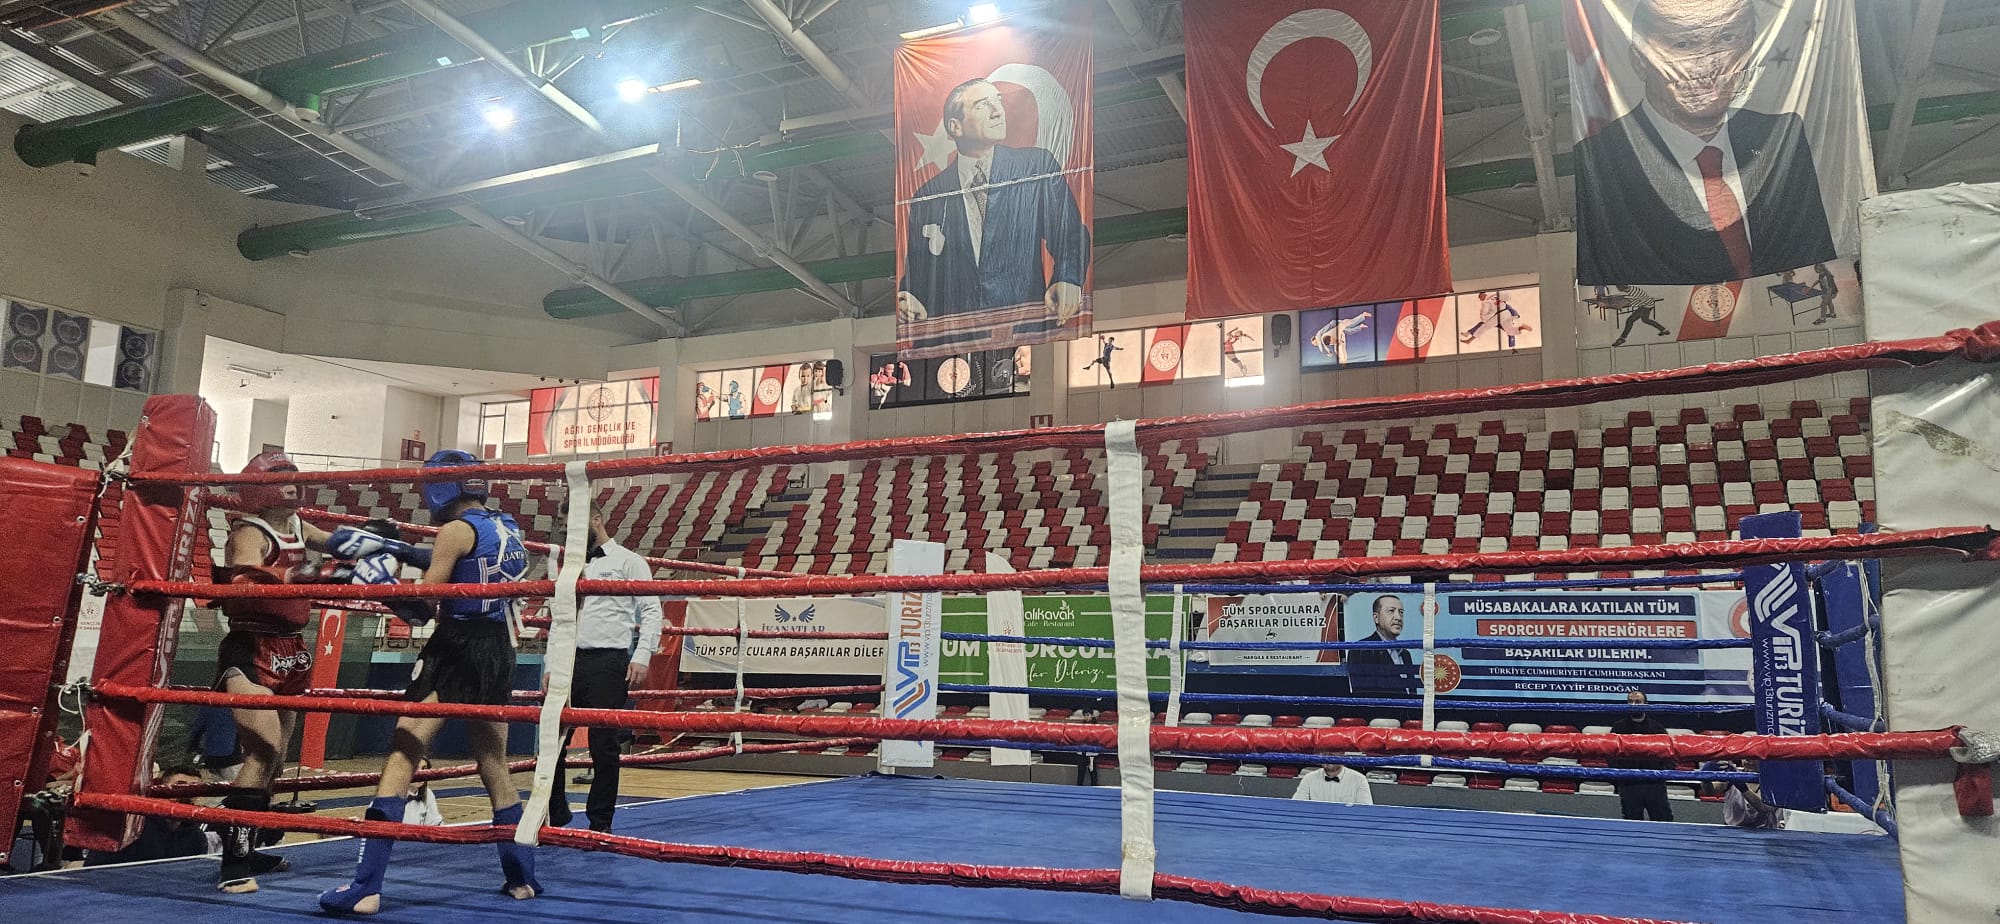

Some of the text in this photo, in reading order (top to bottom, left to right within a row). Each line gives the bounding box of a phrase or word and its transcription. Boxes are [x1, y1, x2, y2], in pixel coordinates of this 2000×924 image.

[565, 421, 636, 435] AĞRI GENÇLİK VE
[564, 434, 635, 448] SPOR İL MÜDÜRLÜĞÜ
[1024, 607, 1075, 620] alıkavak
[1223, 604, 1320, 615] TÜM SPORCULARA
[1464, 599, 1680, 614] MÜSABAKALARA KATILAN TÜM
[901, 592, 923, 640] TURİZ
[1220, 616, 1326, 630] BAŞARILAR DİLERİZ
[1489, 622, 1686, 638] SPORCU VE ANTRENÖRLERE
[1770, 603, 1803, 670] VIP
[695, 644, 884, 659] TÜM SPOCULARA BAŞARILAR DİLER
[910, 642, 921, 653] 13
[941, 638, 981, 657] ÜM
[1505, 648, 1584, 660] BAŞARILAR
[896, 641, 920, 691] VIP
[1774, 655, 1788, 671] 13
[1488, 666, 1666, 679] TÜRKİYE CUMHURİYETİ CUMHURBAŞKANI
[1515, 682, 1640, 693] RECEP TAYYİP ERDOĞAN
[1760, 637, 1775, 736] www.vip13turizm.c
[1775, 672, 1807, 736] TURİZ
